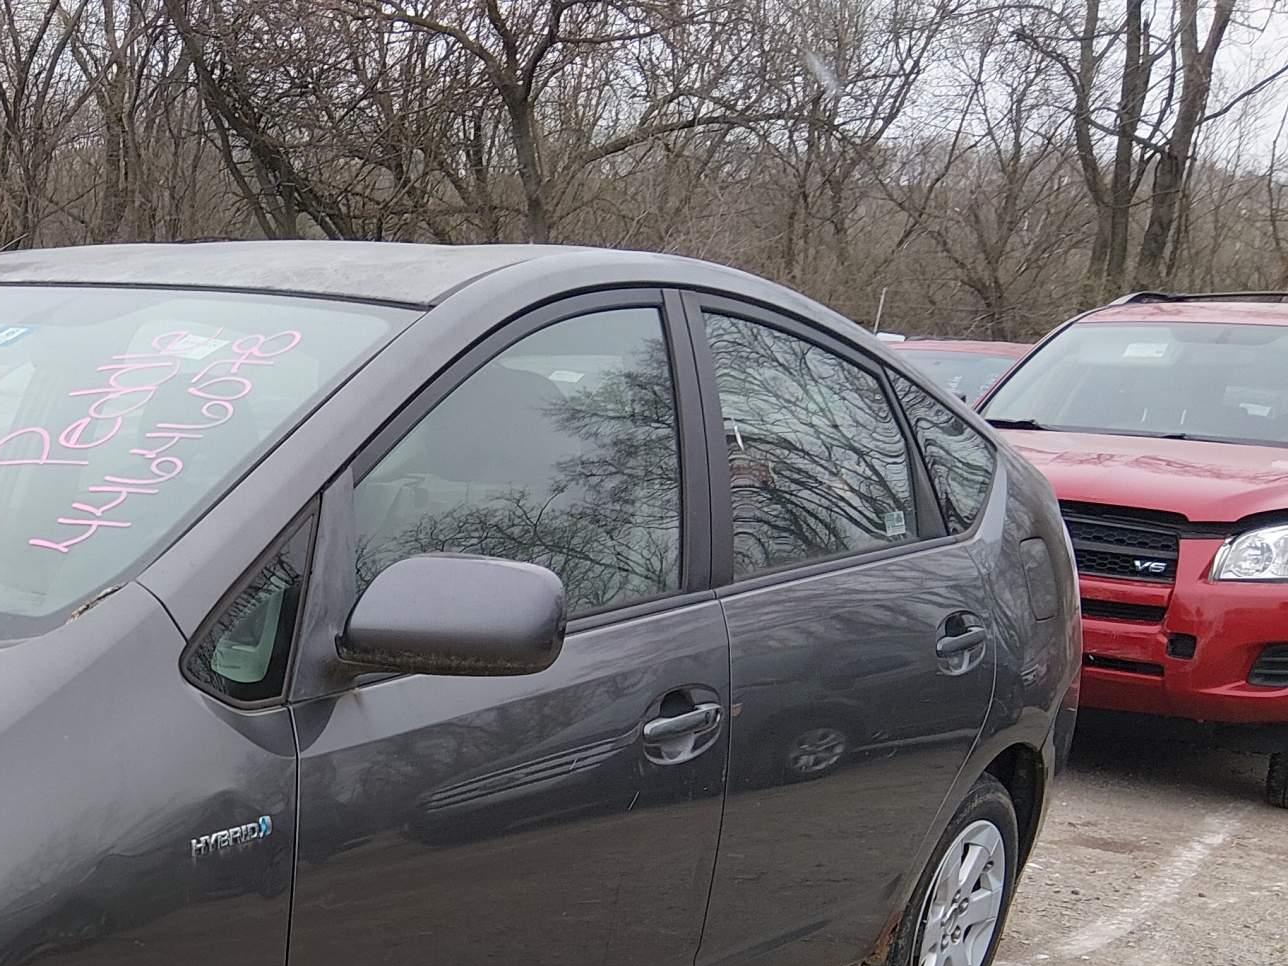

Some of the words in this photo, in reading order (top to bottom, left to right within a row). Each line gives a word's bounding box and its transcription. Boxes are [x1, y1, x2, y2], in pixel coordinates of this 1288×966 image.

[29, 330, 302, 553] 44646078
[1133, 559, 1168, 573] V6
[191, 822, 260, 857] HYBRID
